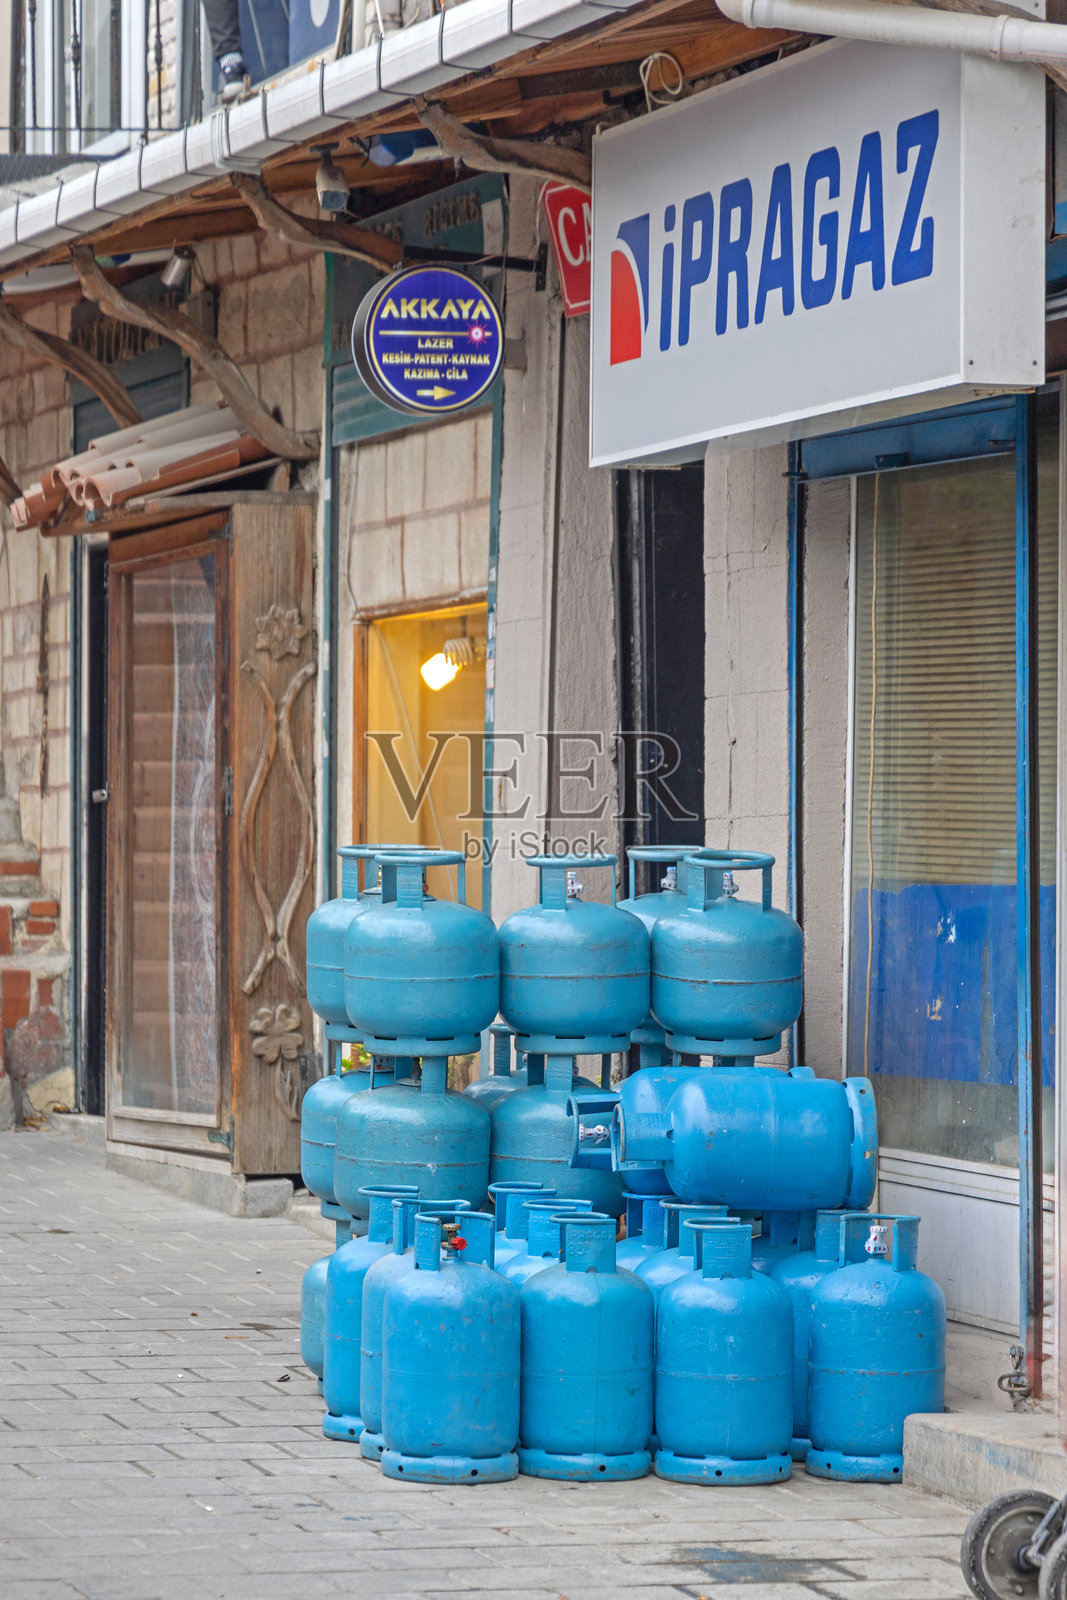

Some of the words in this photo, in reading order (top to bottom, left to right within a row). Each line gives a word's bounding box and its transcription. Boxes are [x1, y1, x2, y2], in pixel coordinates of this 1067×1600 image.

[380, 297, 491, 319] AKKAYA
[418, 338, 454, 349] LAZER
[404, 368, 440, 380] KAZIMA
